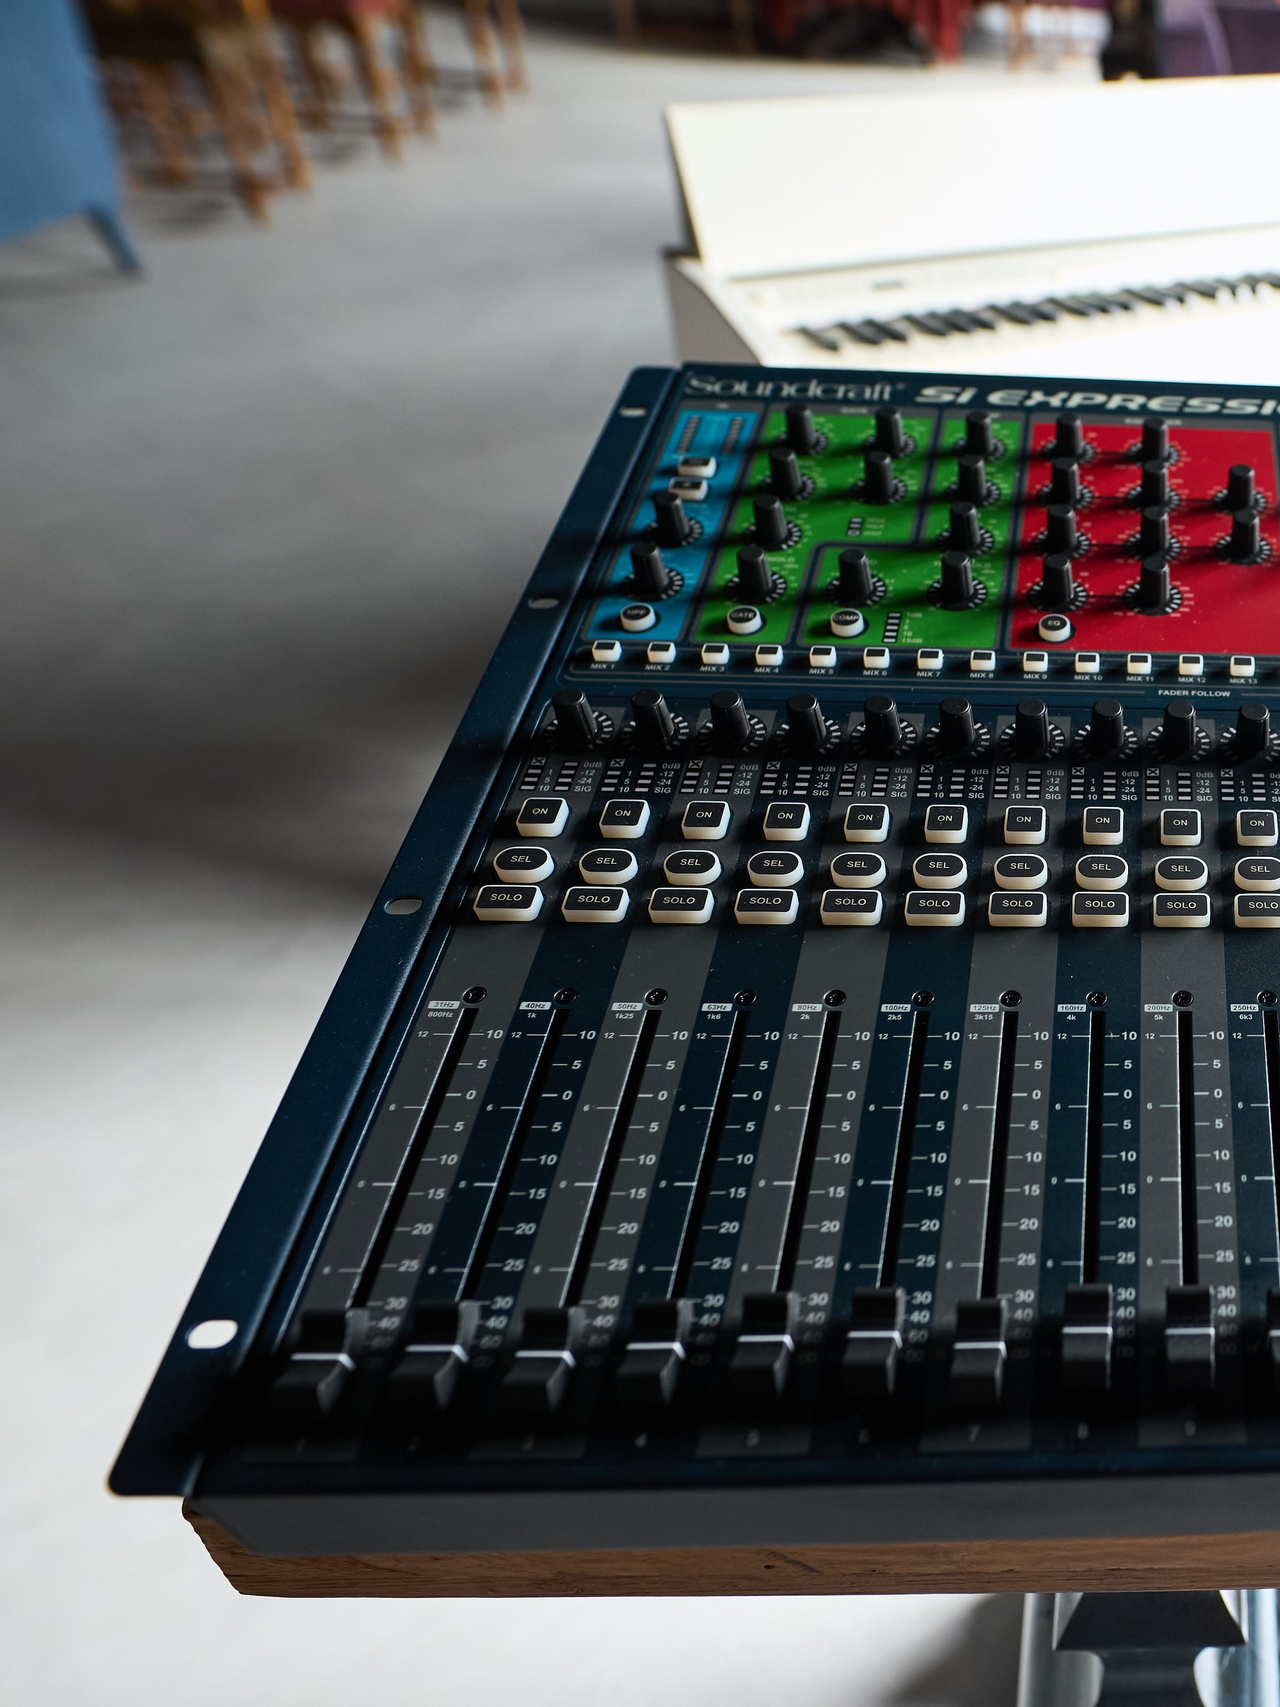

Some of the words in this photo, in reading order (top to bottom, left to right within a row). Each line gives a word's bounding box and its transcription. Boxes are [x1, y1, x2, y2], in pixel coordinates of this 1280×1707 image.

[684, 375, 893, 401] Soundcraft
[577, 895, 611, 903] SOLO
[662, 896, 696, 904] SOLO
[1122, 1032, 1137, 1040] 10
[1124, 1060, 1132, 1069] 5
[1124, 1090, 1132, 1099] 0
[1123, 1120, 1132, 1130] 5
[1119, 1151, 1136, 1161] 10
[1119, 1184, 1136, 1194] 15
[1117, 1217, 1136, 1228] 20
[1117, 1252, 1135, 1264] 25
